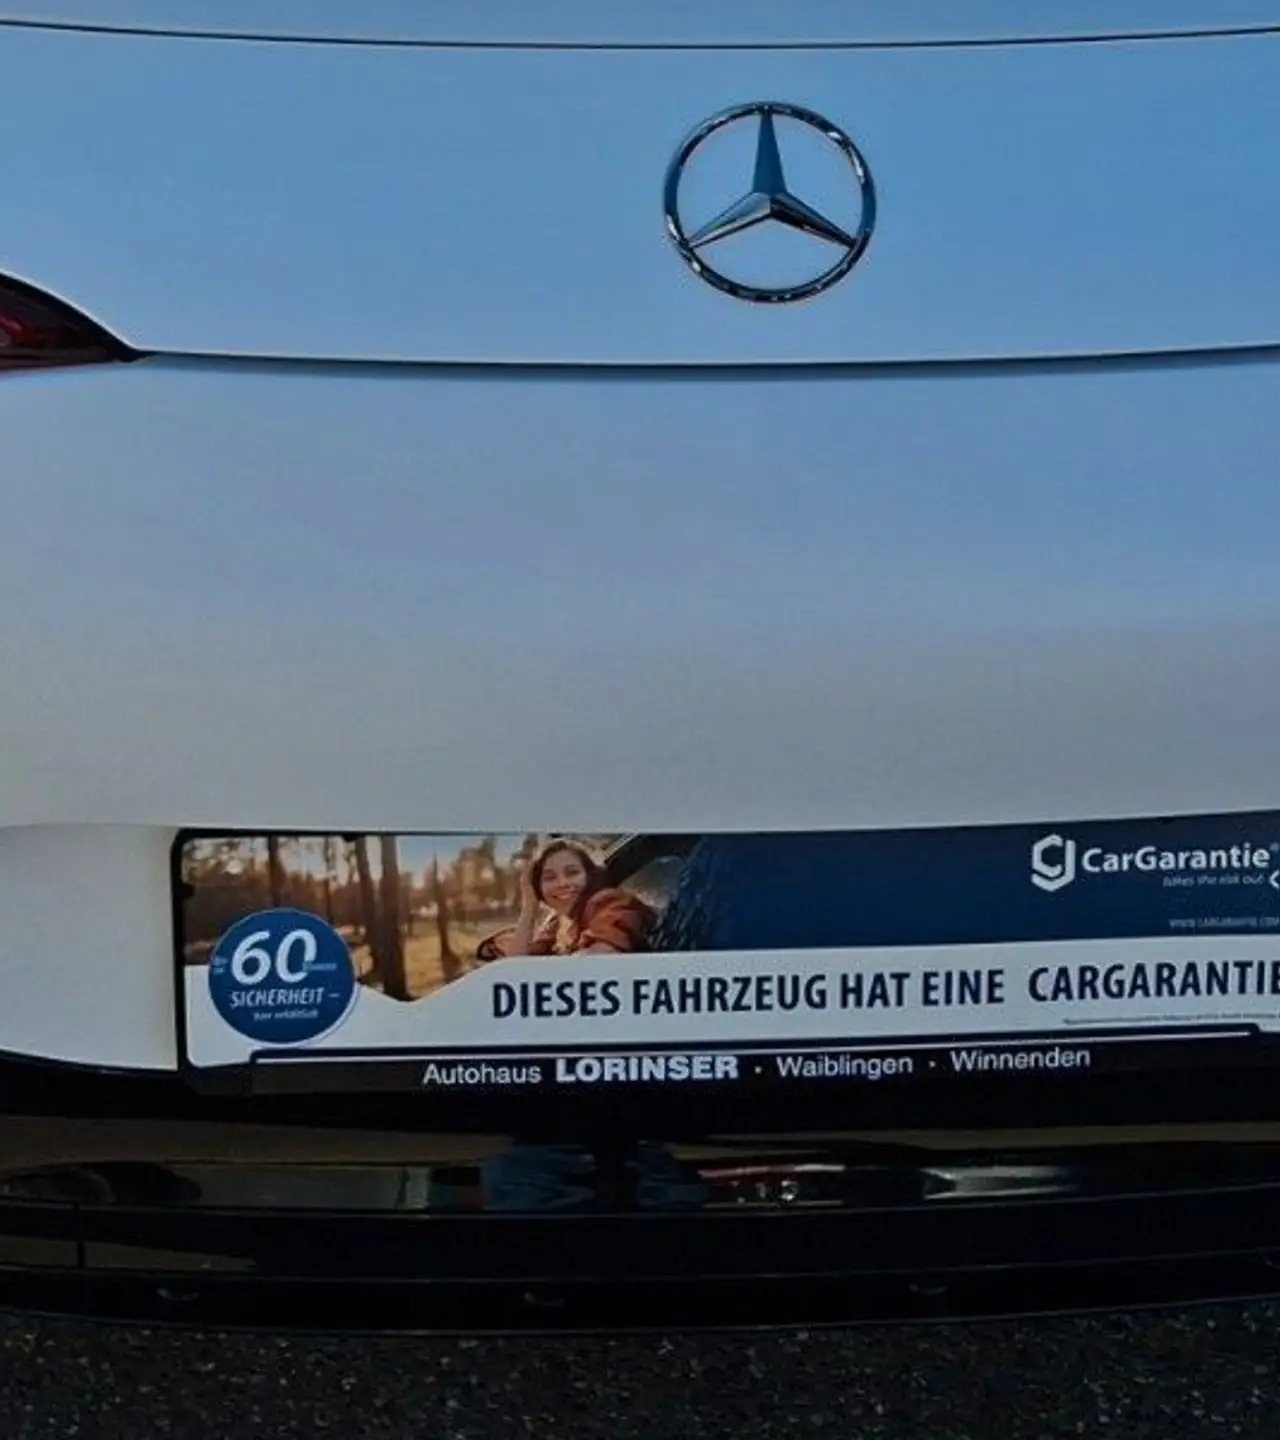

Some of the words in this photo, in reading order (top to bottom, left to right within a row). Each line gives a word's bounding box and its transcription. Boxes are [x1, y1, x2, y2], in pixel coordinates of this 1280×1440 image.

[231, 928, 318, 986] 60
[229, 988, 325, 1008] SICHERHEIT
[492, 980, 621, 1018] DIESES
[632, 974, 827, 1014] FAHRZEUG
[839, 972, 912, 1009] HAT
[922, 968, 1005, 1006] EINE
[422, 1063, 542, 1084] Autohaus
[555, 1056, 739, 1083] LORINSER
[776, 1054, 914, 1081] Waiblingen
[949, 1046, 1091, 1072] Winnenden
